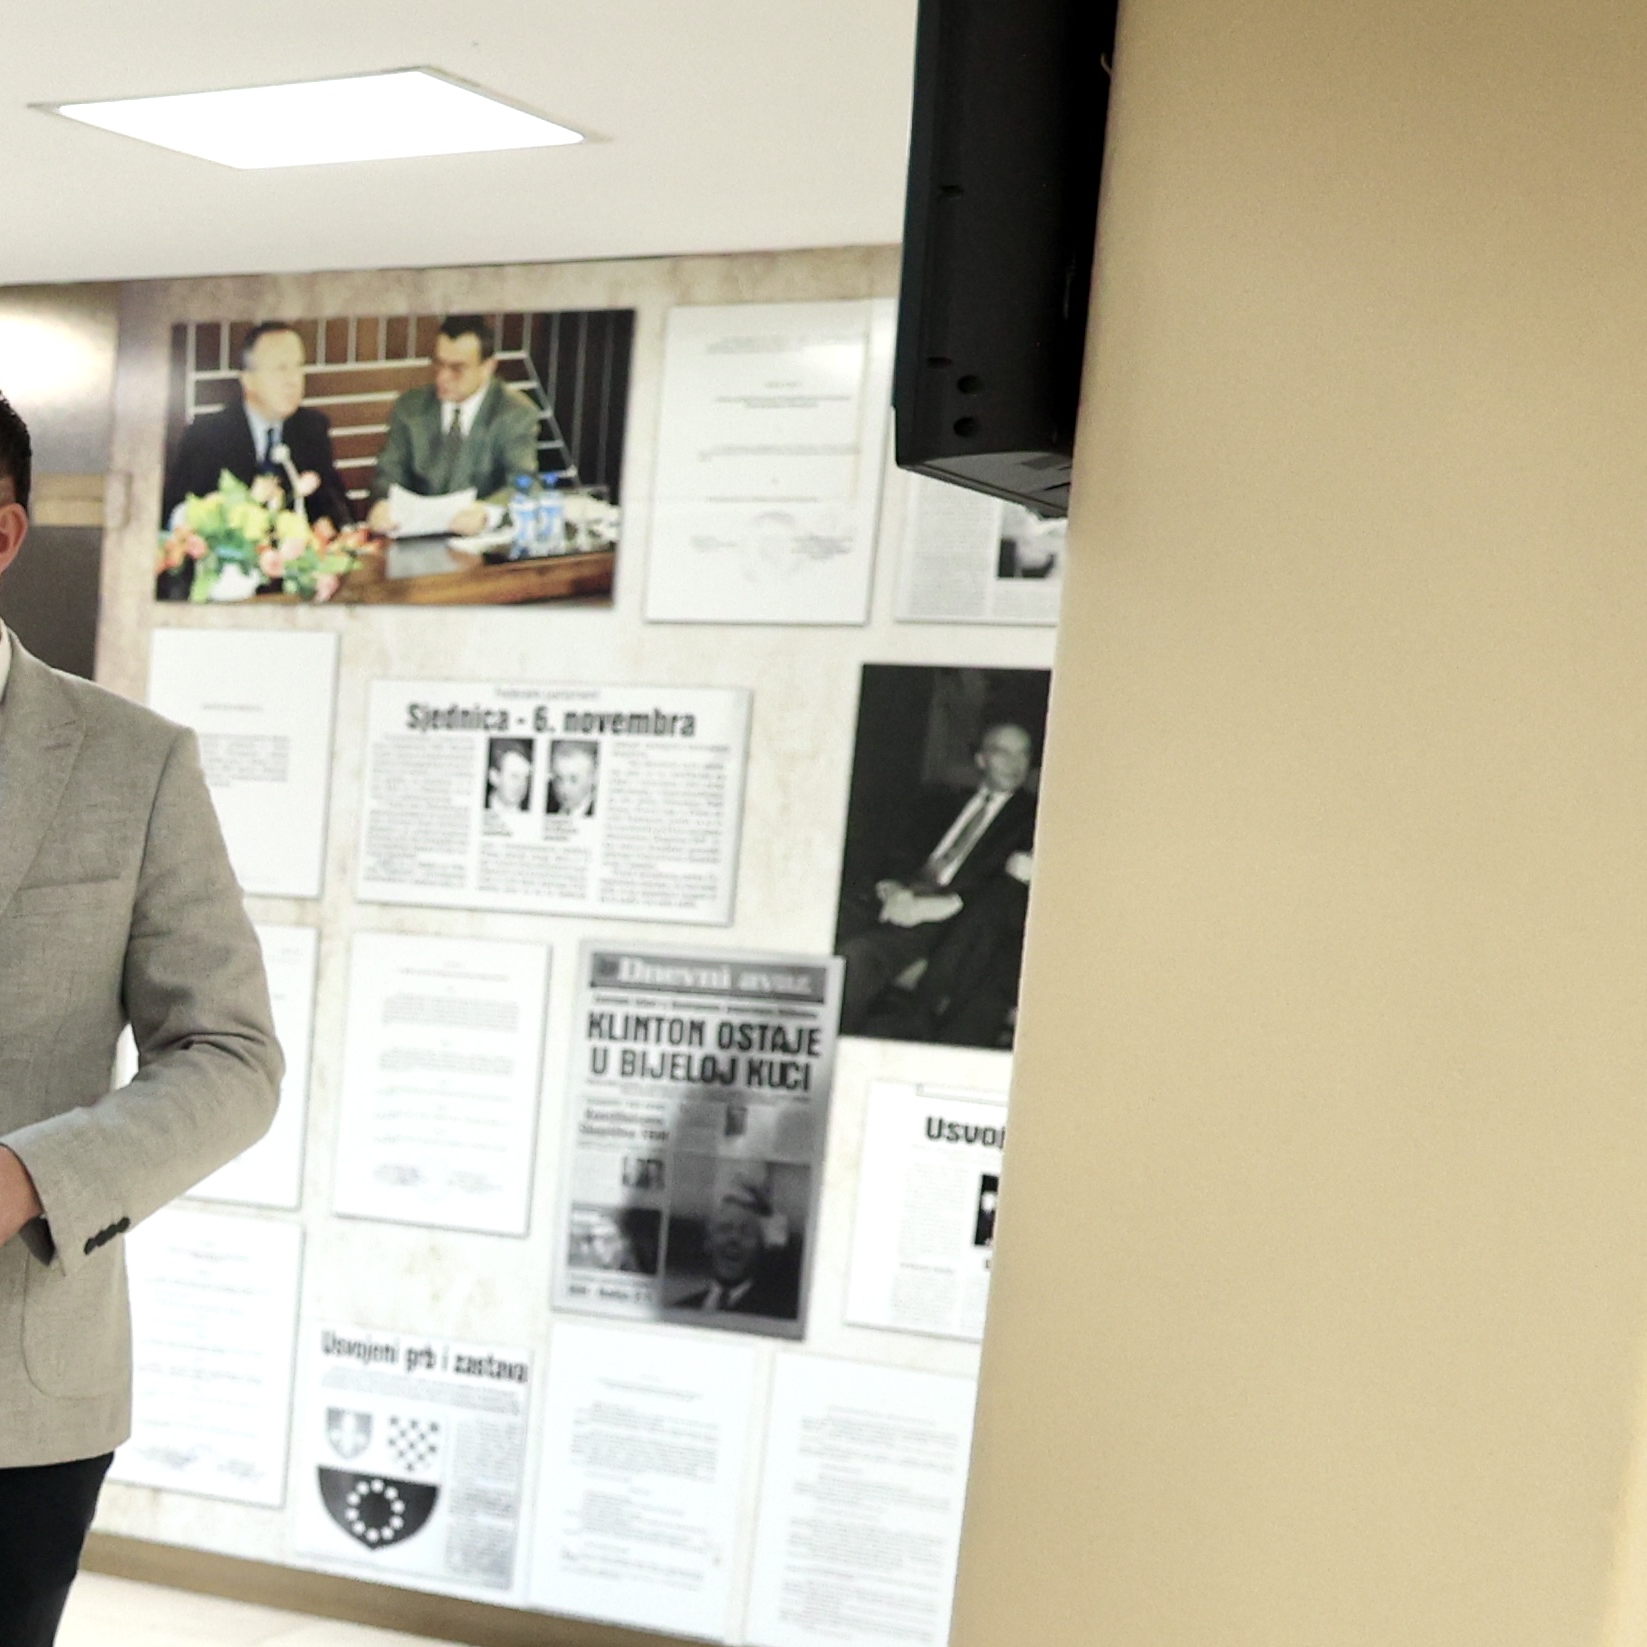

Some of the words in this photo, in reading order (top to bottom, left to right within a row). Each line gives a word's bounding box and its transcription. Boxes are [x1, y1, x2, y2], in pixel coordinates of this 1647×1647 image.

[407, 703, 509, 732] Sjednica
[563, 706, 696, 736] novembra
[588, 1011, 706, 1048] KLINTON
[718, 1021, 821, 1057] OSTAJE
[592, 1047, 608, 1075] U
[621, 1049, 738, 1086] BIJELOJ
[320, 1328, 400, 1366] Usvojeni
[453, 1351, 529, 1385] zastava
